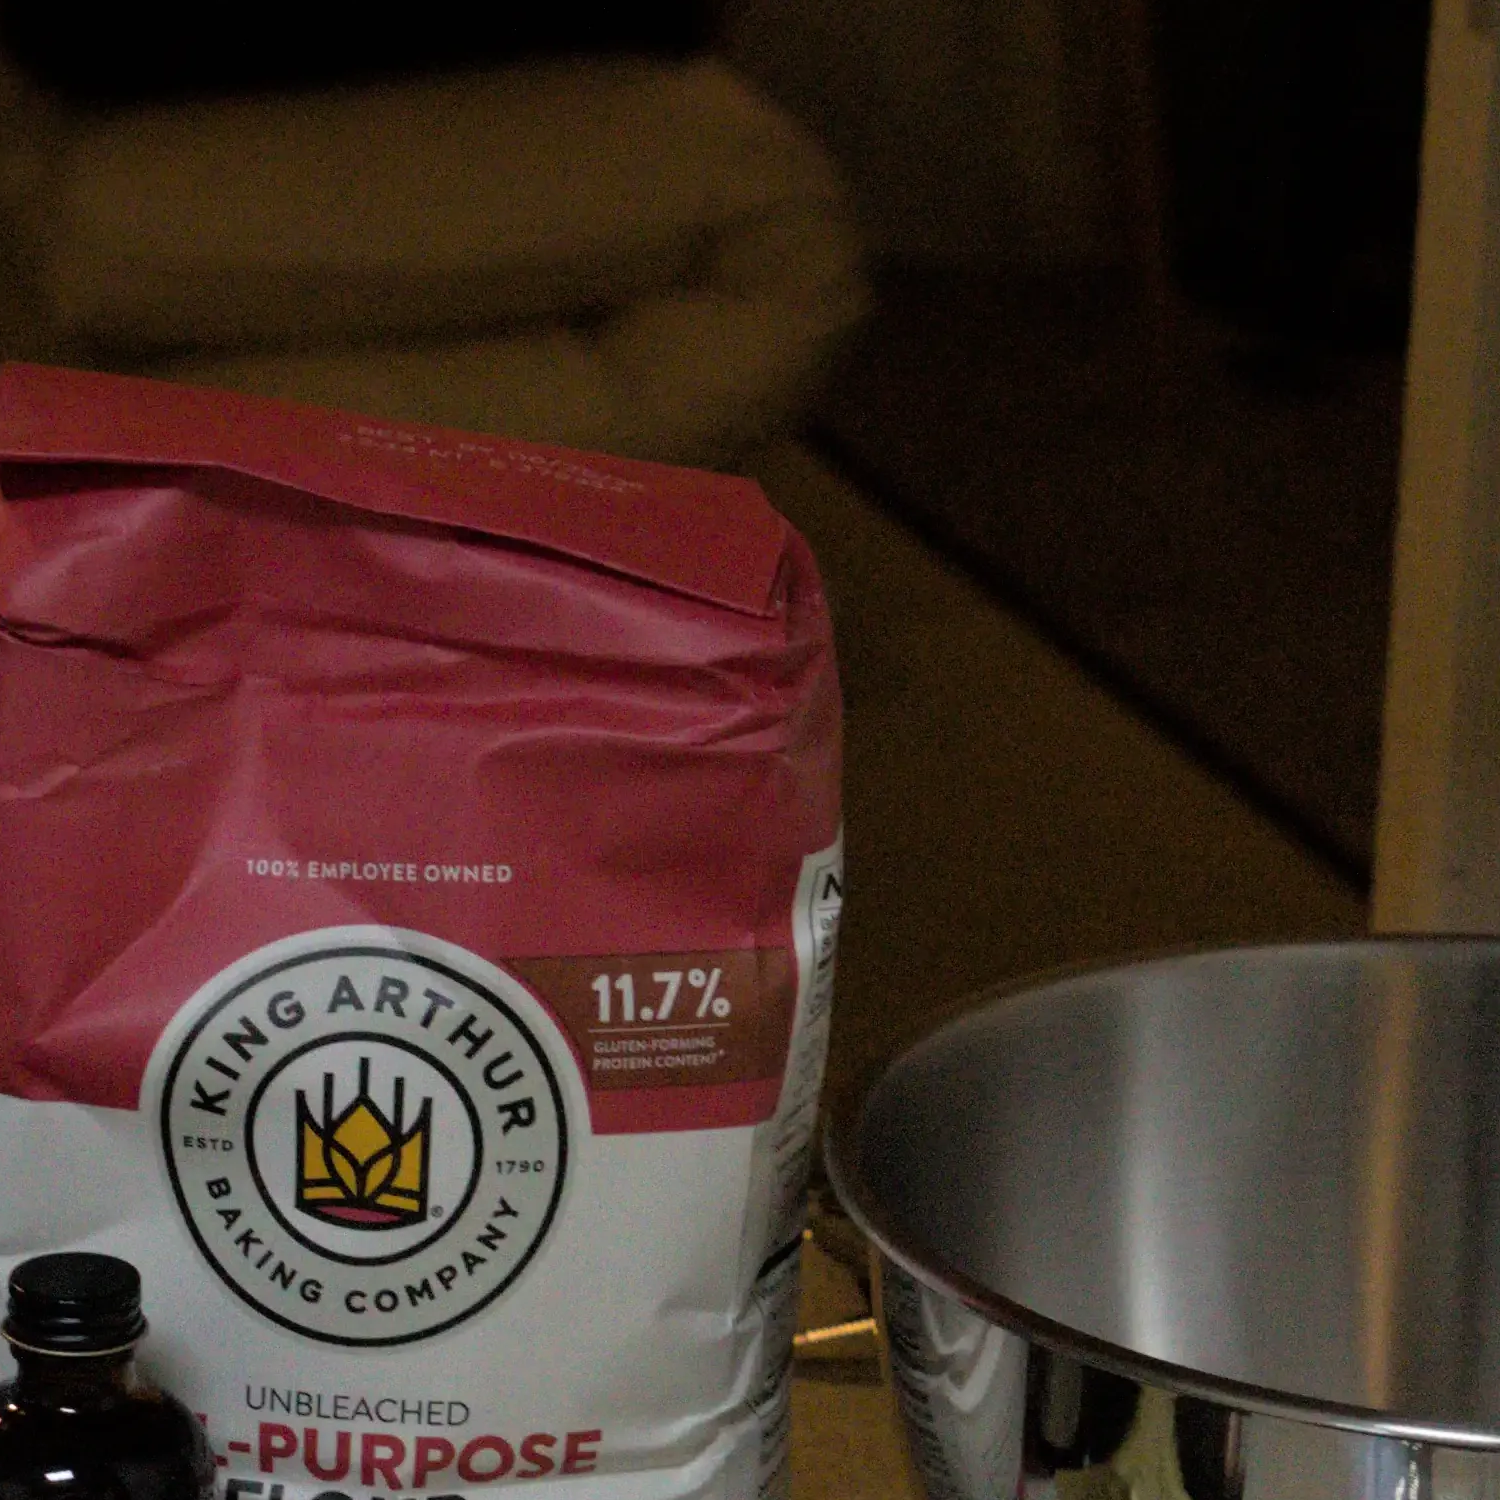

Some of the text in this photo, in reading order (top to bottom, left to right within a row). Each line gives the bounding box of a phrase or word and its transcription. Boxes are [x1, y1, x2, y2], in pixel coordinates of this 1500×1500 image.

[245, 859, 513, 884] 100% EMPLOYEE OWNED
[591, 967, 732, 1024] 11.7%
[188, 974, 538, 1136] KING ARTHUR
[591, 1055, 652, 1071] PROTEIN
[495, 1158, 546, 1174] 1790
[204, 1175, 521, 1313] BAKING COMPANY
[244, 1383, 471, 1427] UNBLEACHED
[200, 1411, 603, 1491] -PURPOSE
